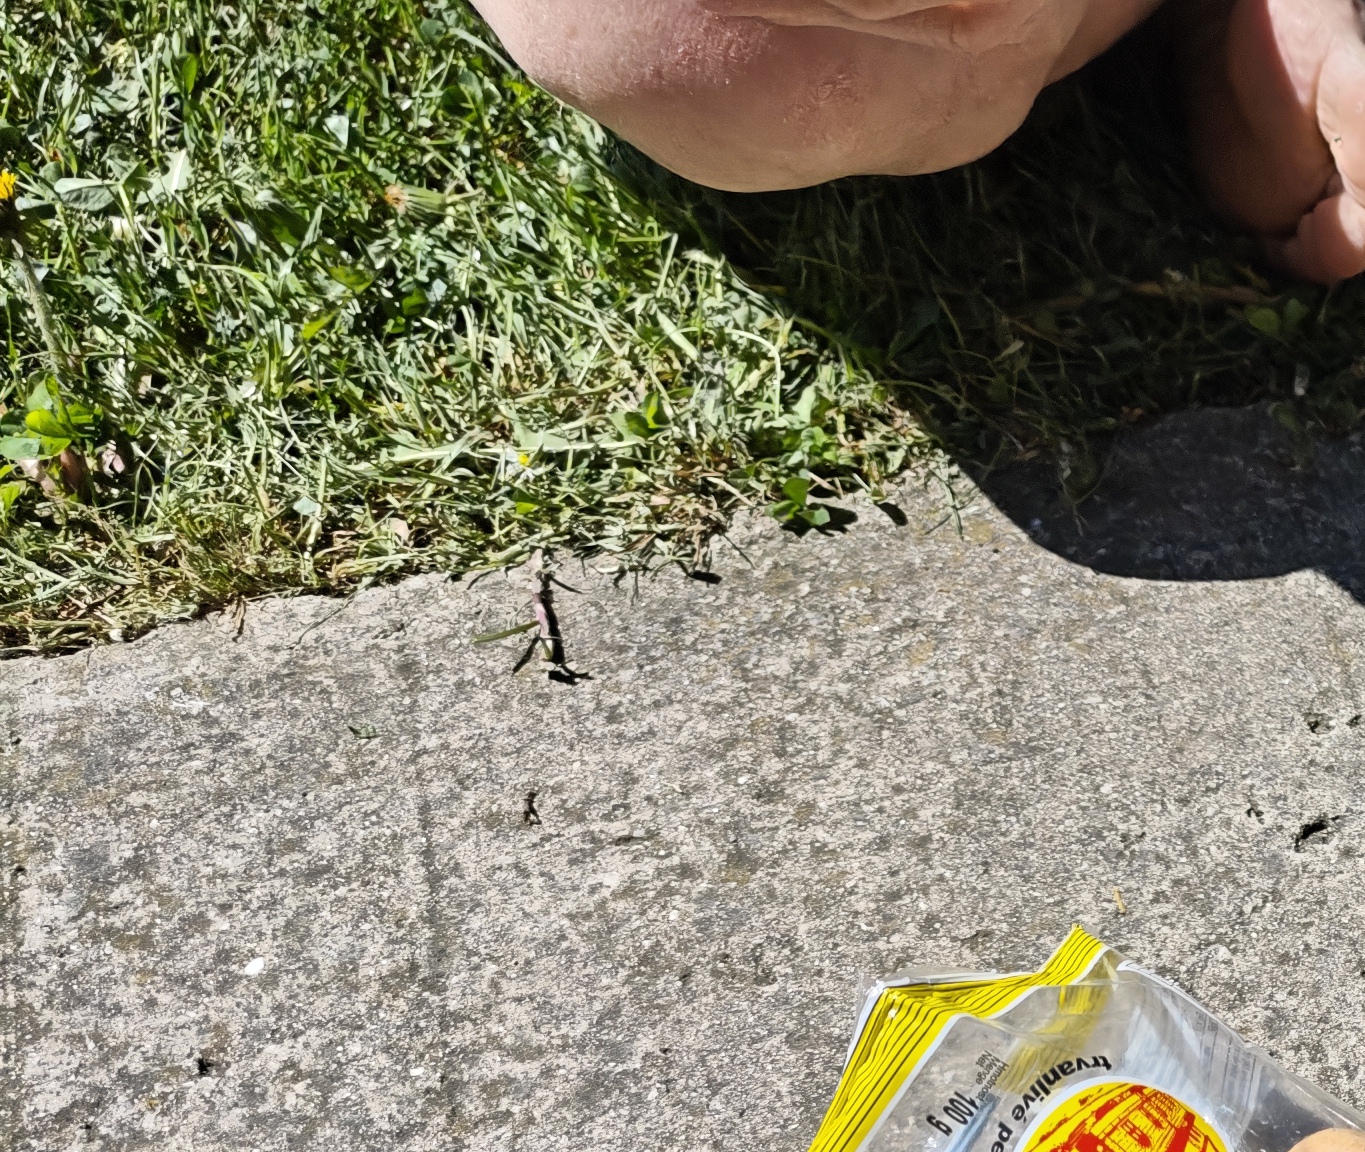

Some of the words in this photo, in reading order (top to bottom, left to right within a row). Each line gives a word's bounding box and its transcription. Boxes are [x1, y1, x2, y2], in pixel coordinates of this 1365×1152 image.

[971, 1052, 1001, 1088] Menge
[973, 1047, 994, 1070] Net
[973, 1059, 1010, 1104] Hmotnost
[1006, 1056, 1110, 1125] trvanlivé
[924, 1112, 955, 1138] g
[940, 1089, 980, 1127] 100
